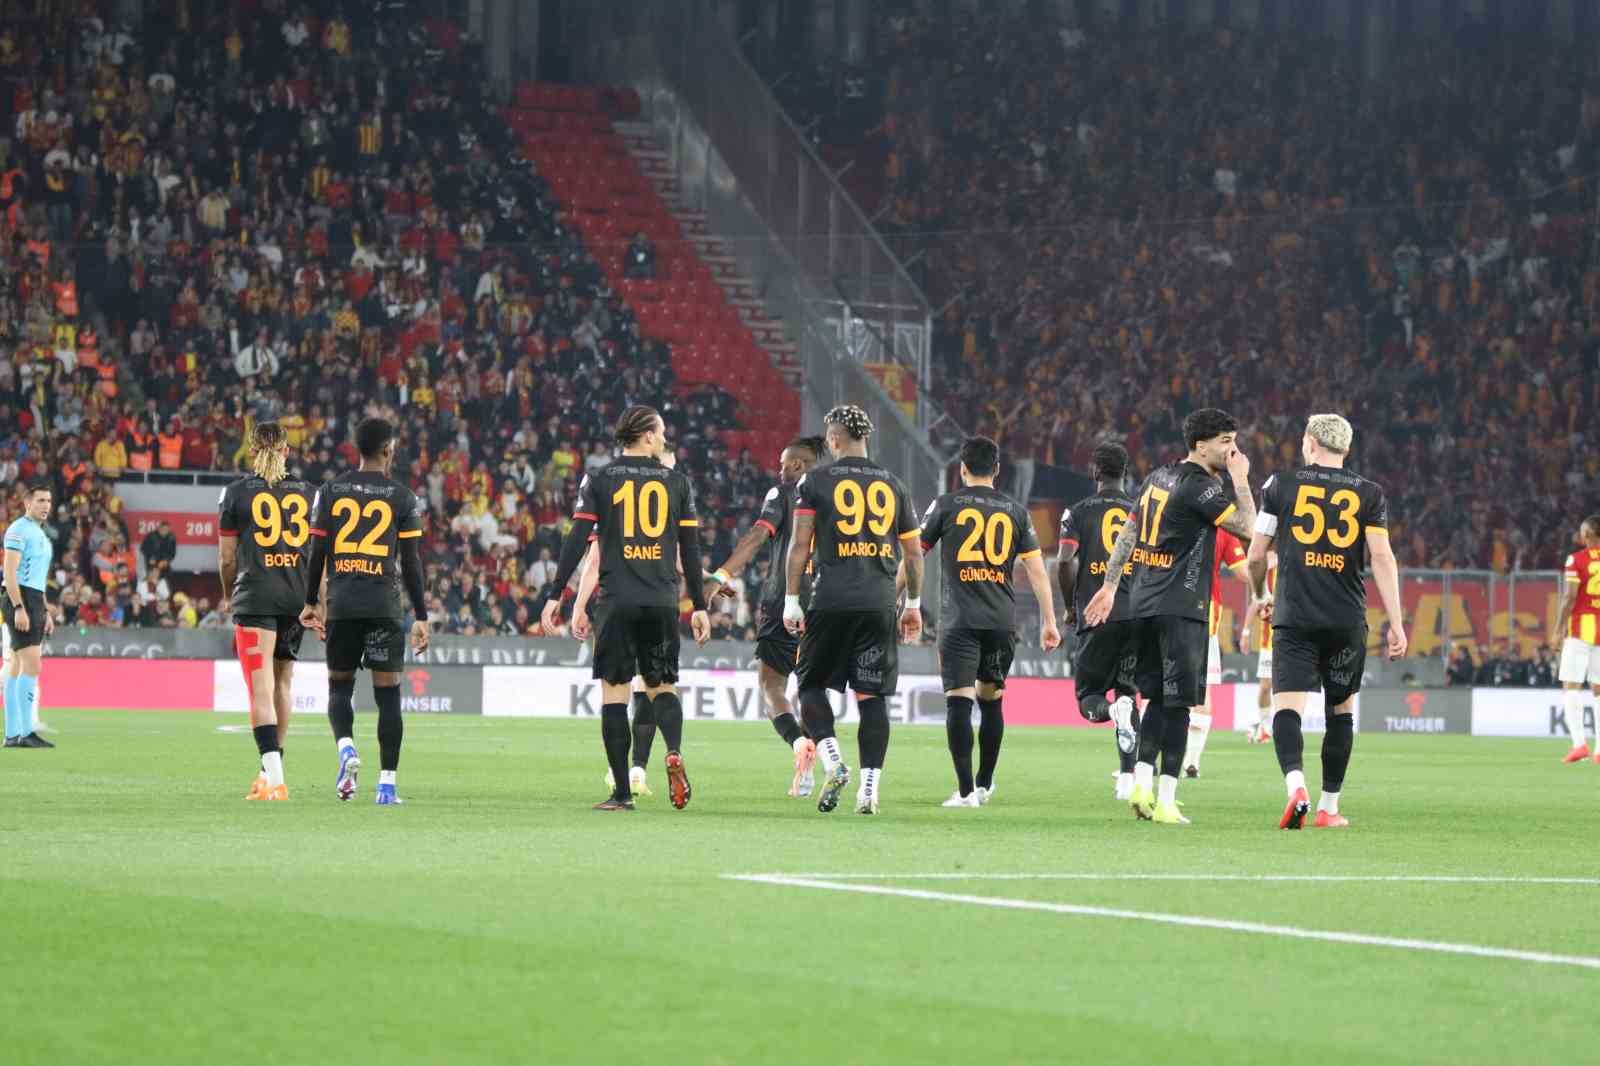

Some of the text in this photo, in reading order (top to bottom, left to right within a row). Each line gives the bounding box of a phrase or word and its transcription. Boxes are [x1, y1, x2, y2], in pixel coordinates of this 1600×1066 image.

[185, 522, 213, 536] 208
[251, 492, 310, 548] 93
[331, 497, 393, 557] 22
[613, 480, 669, 538] 10
[833, 479, 896, 536] 99
[1138, 484, 1169, 547] 17
[1291, 484, 1361, 549] 53
[264, 553, 300, 568] BOEY
[624, 543, 662, 560] SANÉ
[838, 542, 877, 558] MARIO
[956, 507, 1013, 566] 20
[1305, 552, 1345, 573] BARIŞ
[1384, 717, 1446, 732] TUNSER
